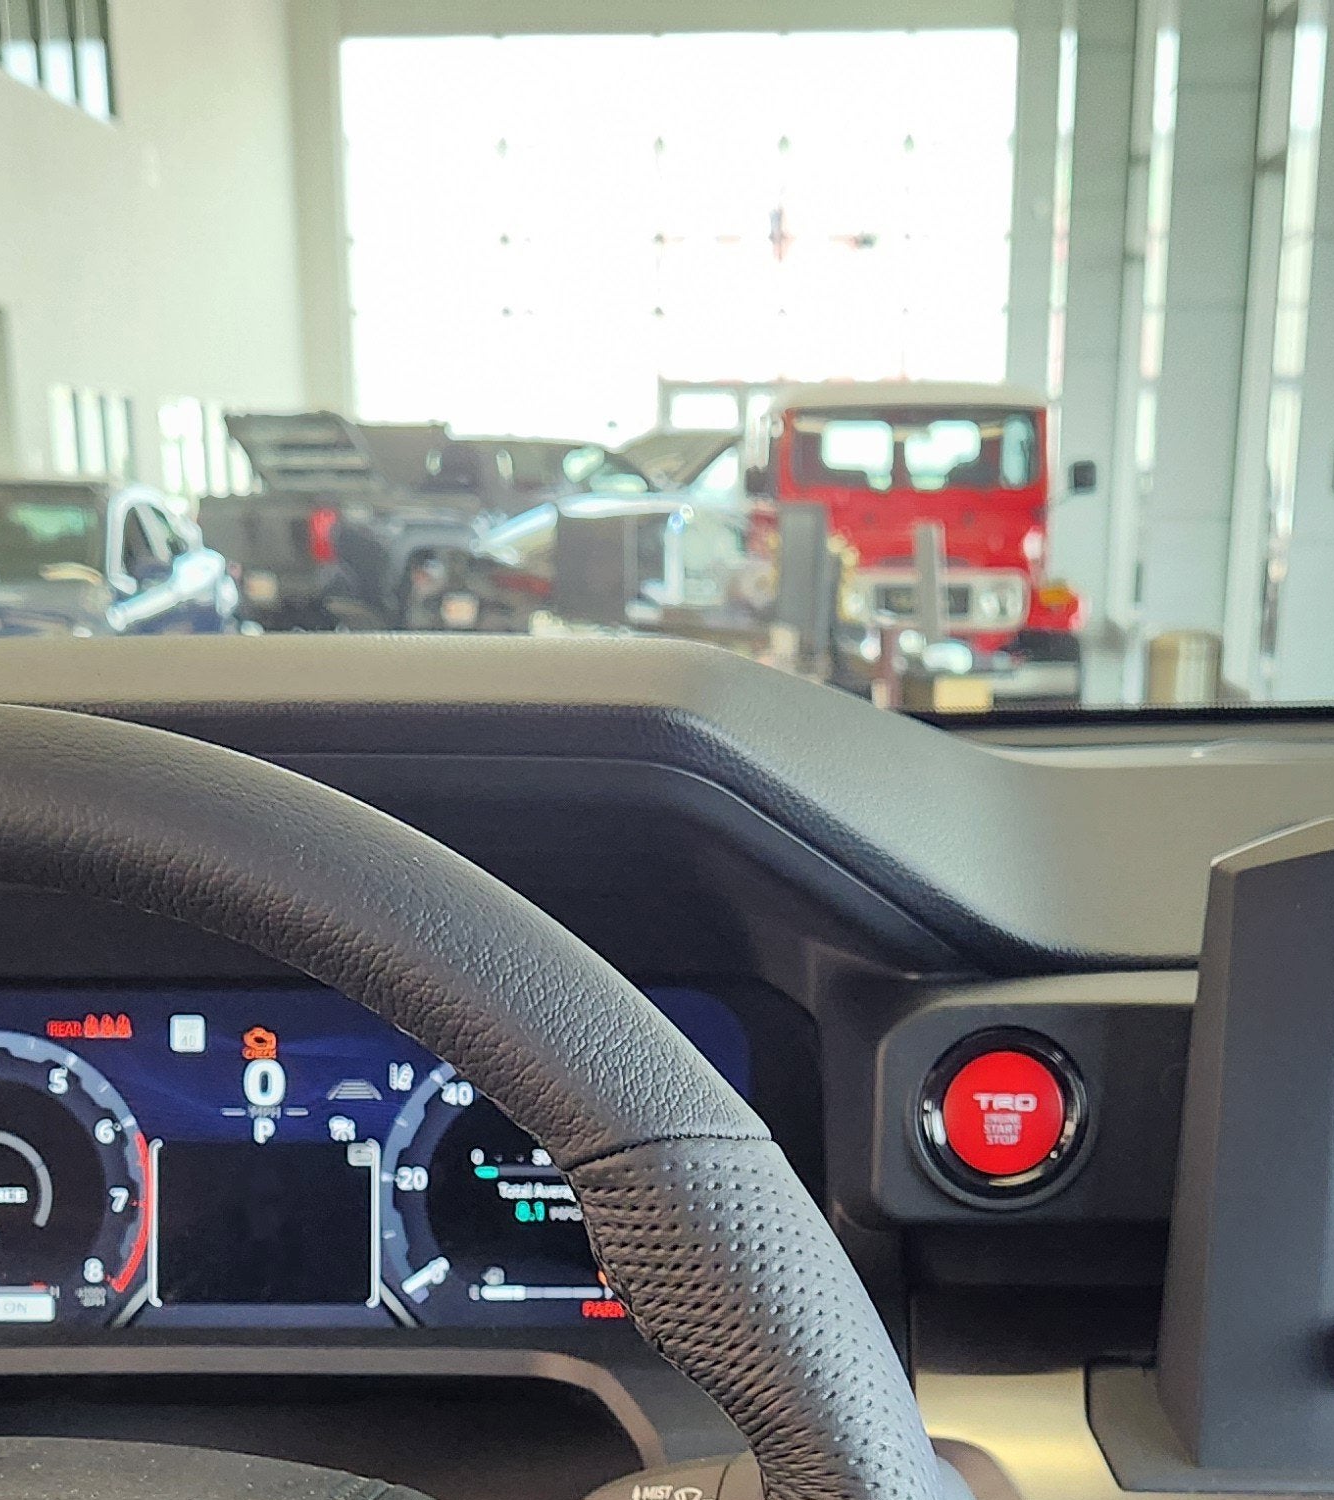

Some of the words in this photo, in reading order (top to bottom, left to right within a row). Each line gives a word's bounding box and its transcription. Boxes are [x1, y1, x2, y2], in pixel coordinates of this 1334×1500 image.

[48, 1068, 68, 1094] 5
[243, 1058, 287, 1106] 0
[442, 1081, 475, 1106] 40
[972, 1092, 1038, 1112] TRD
[94, 1118, 116, 1144] 6
[253, 1117, 276, 1144] P
[985, 1134, 1020, 1146] STOP
[396, 1166, 429, 1190] 20
[109, 1187, 129, 1212] 7
[83, 1258, 105, 1283] 8
[9, 1301, 28, 1314] ON
[641, 1485, 674, 1500] MIST
